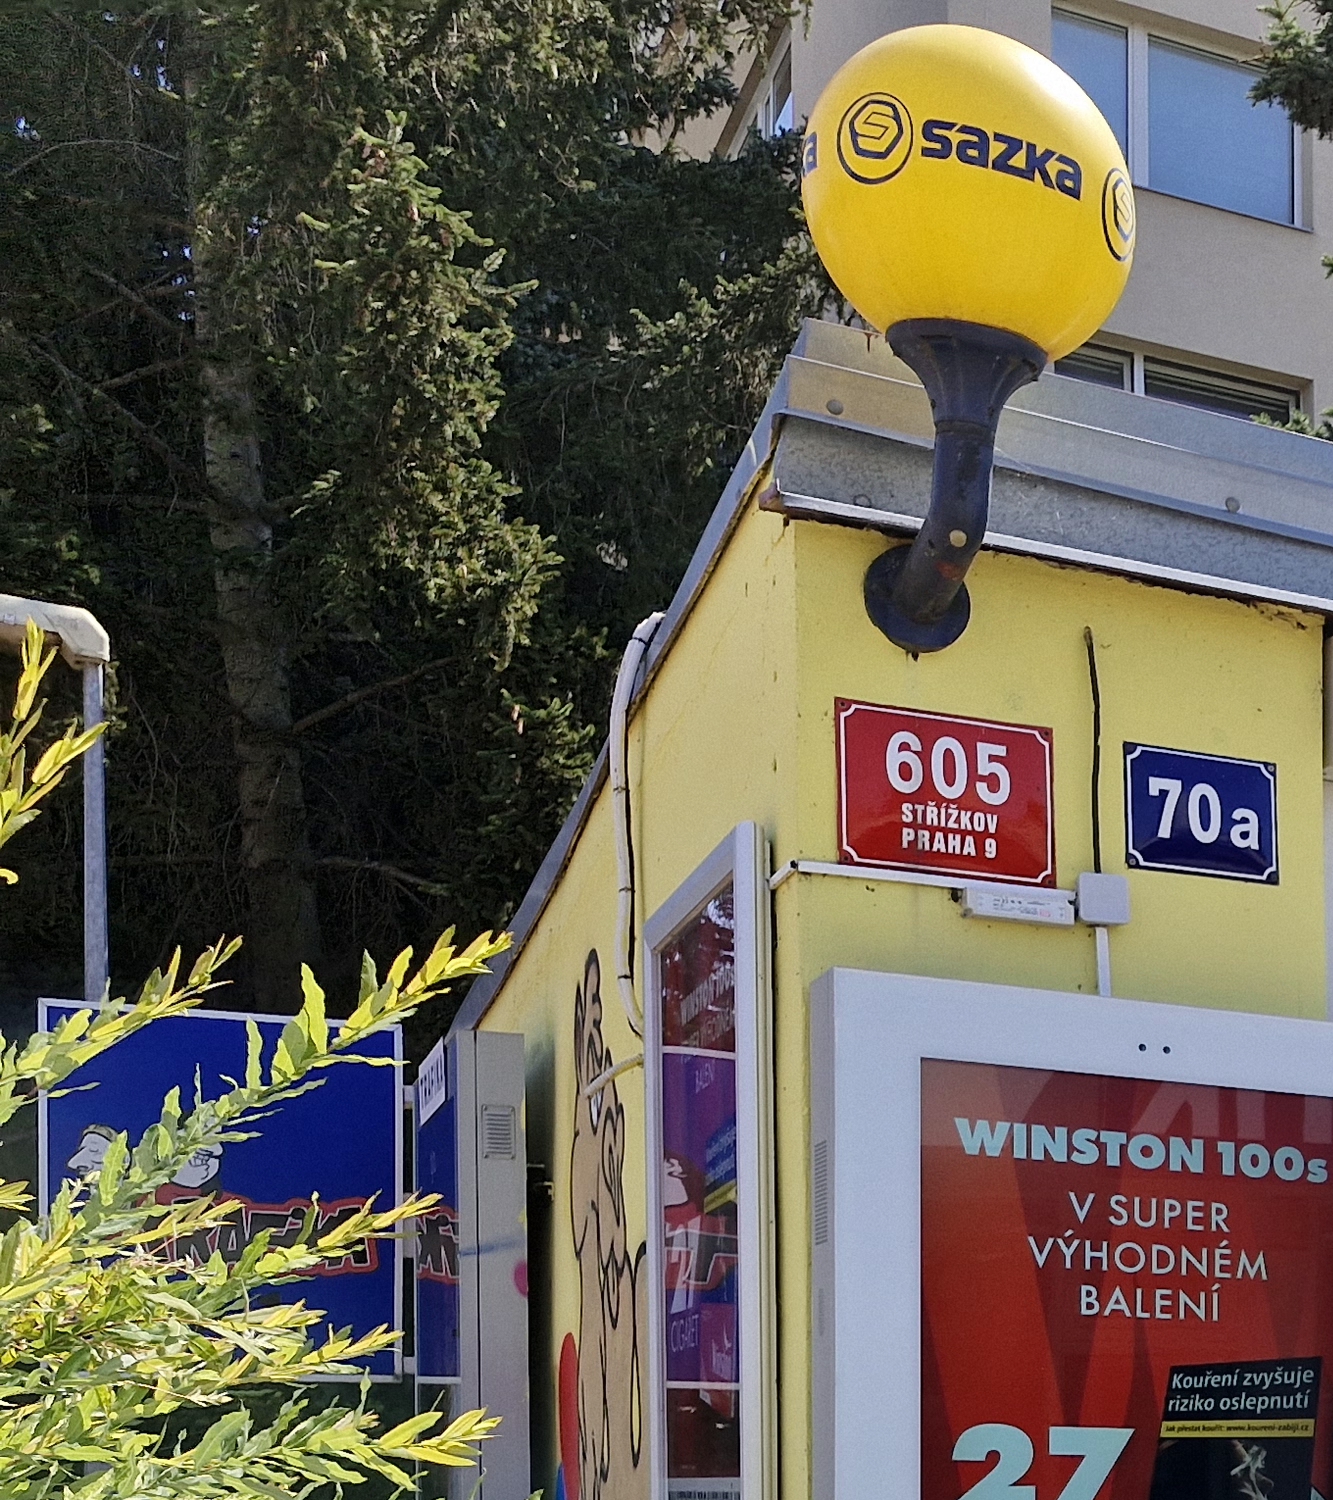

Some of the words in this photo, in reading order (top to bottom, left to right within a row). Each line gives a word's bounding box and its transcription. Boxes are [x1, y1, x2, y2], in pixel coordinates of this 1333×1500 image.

[885, 730, 1012, 806] 605
[901, 801, 999, 834] STŘÍŽKOV
[1148, 776, 1260, 852] 70a
[902, 827, 976, 857] PRAHA
[985, 836, 997, 859] 9
[954, 1117, 1204, 1174] WINSTON
[1217, 1141, 1329, 1184] 100s
[1069, 1191, 1095, 1224] V
[1108, 1194, 1231, 1232] SUPER
[1027, 1231, 1269, 1281] VÝHODNÉM
[1079, 1283, 1220, 1322] BALENÍ
[1171, 1369, 1240, 1389] Kouření
[1243, 1366, 1315, 1390] zvyšuje
[1168, 1394, 1215, 1412] riziko
[1219, 1389, 1311, 1414] oslepnutí
